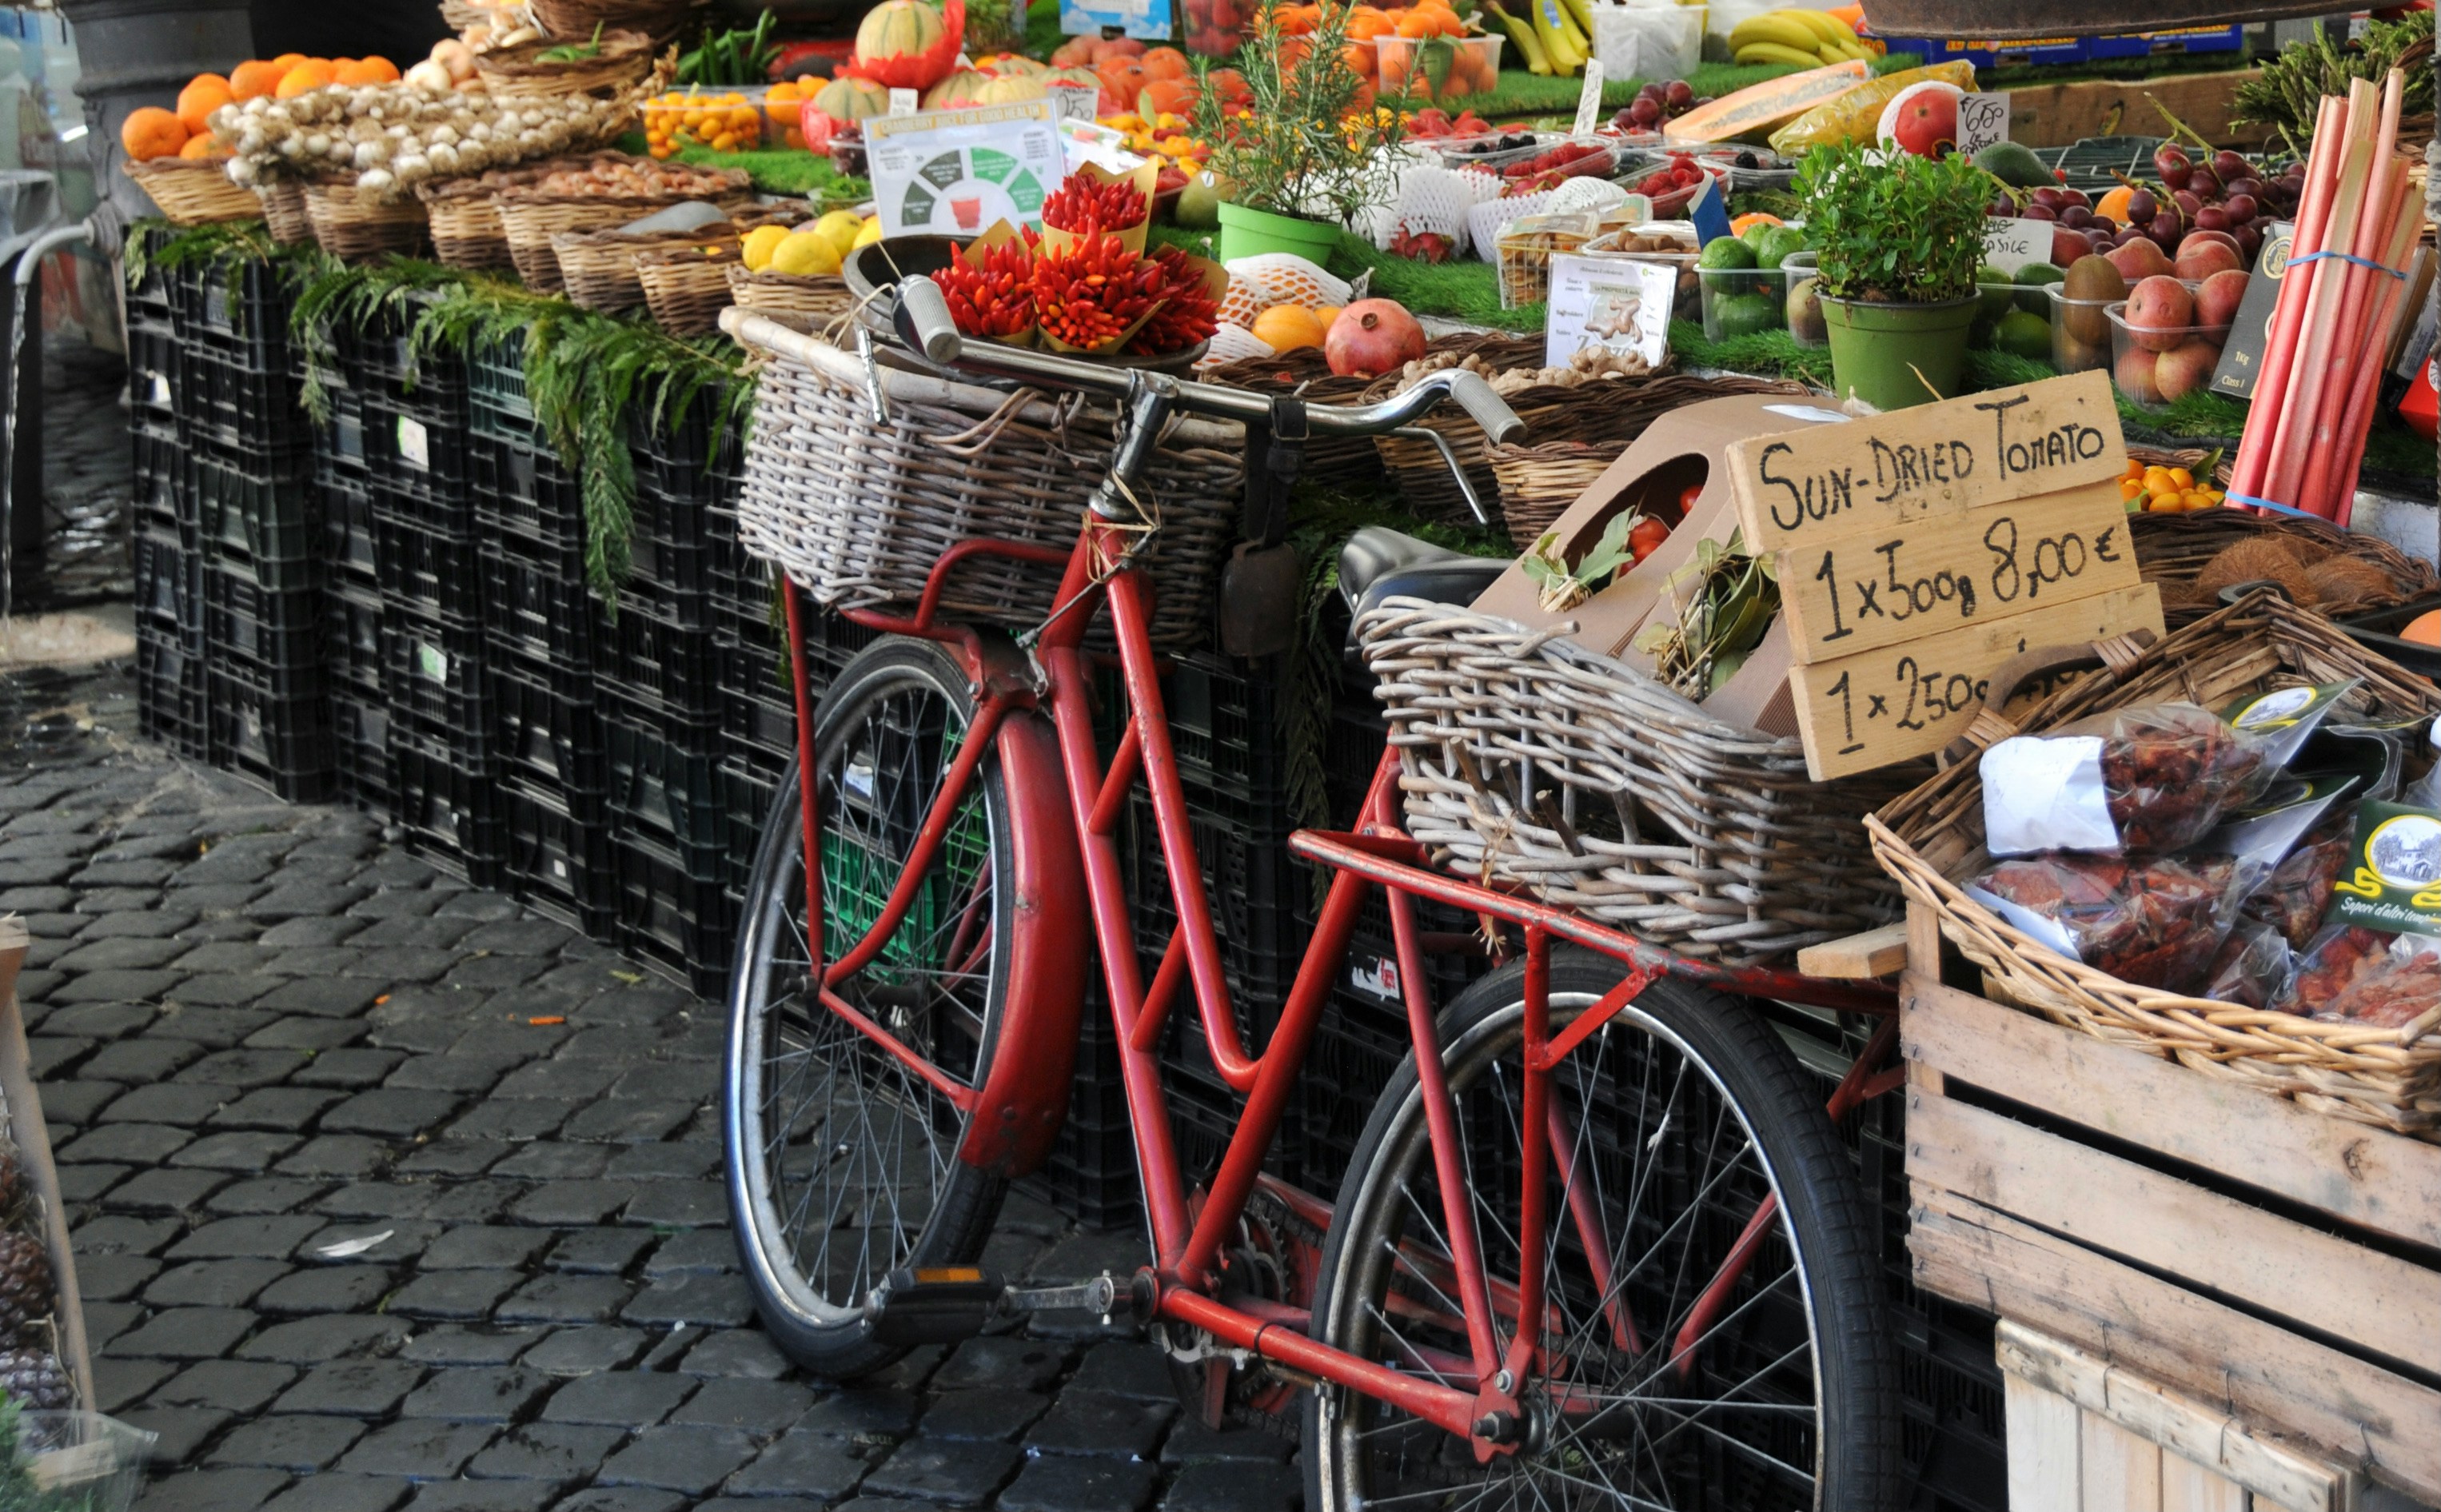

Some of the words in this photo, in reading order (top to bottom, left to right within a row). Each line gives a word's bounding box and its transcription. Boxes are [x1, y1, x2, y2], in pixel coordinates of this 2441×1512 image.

[959, 112, 977, 125] FOR
[979, 110, 1003, 124] GOOD
[1003, 104, 1039, 121] HEALTH
[2340, 896, 2375, 916] Sapori
